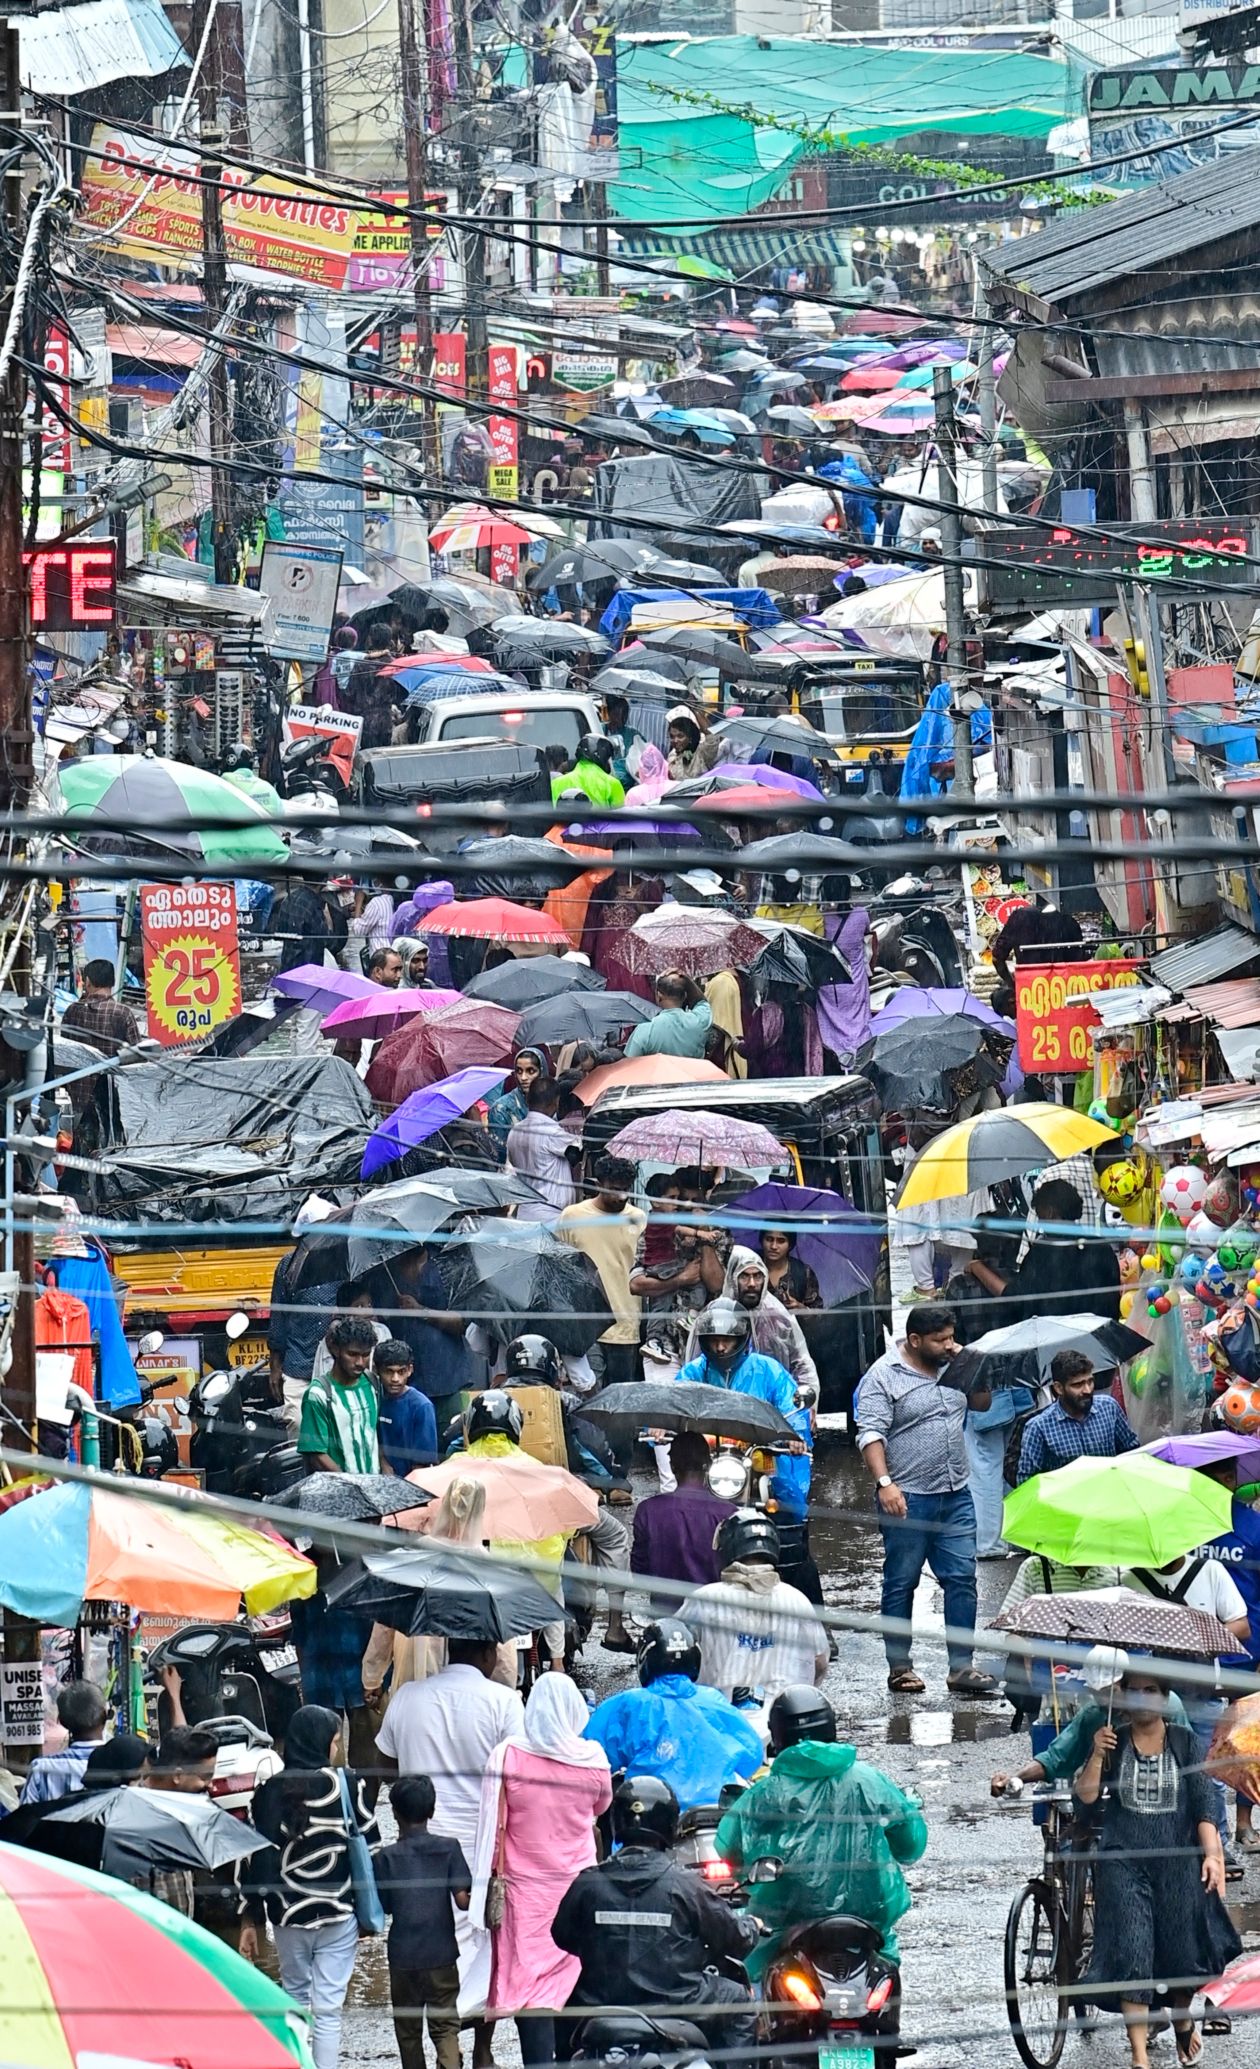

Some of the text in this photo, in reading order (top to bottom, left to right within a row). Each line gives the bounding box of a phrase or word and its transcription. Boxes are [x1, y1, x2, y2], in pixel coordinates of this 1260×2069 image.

[136, 223, 157, 238] CAPS
[169, 218, 200, 236] SPORTS
[239, 236, 257, 251] BOX
[492, 431, 515, 445] OFFER
[494, 469, 513, 477] MEGA
[493, 549, 515, 564] OFFER
[289, 708, 306, 718] NO
[145, 886, 231, 910] ഏതെടു
[148, 908, 231, 930] ത്താലും
[163, 948, 220, 1007] 25
[176, 1008, 211, 1030] രൂപ
[1032, 1025, 1060, 1061] 25
[17, 1686, 42, 1698] SPA
[6, 1726, 25, 1737] 9061
